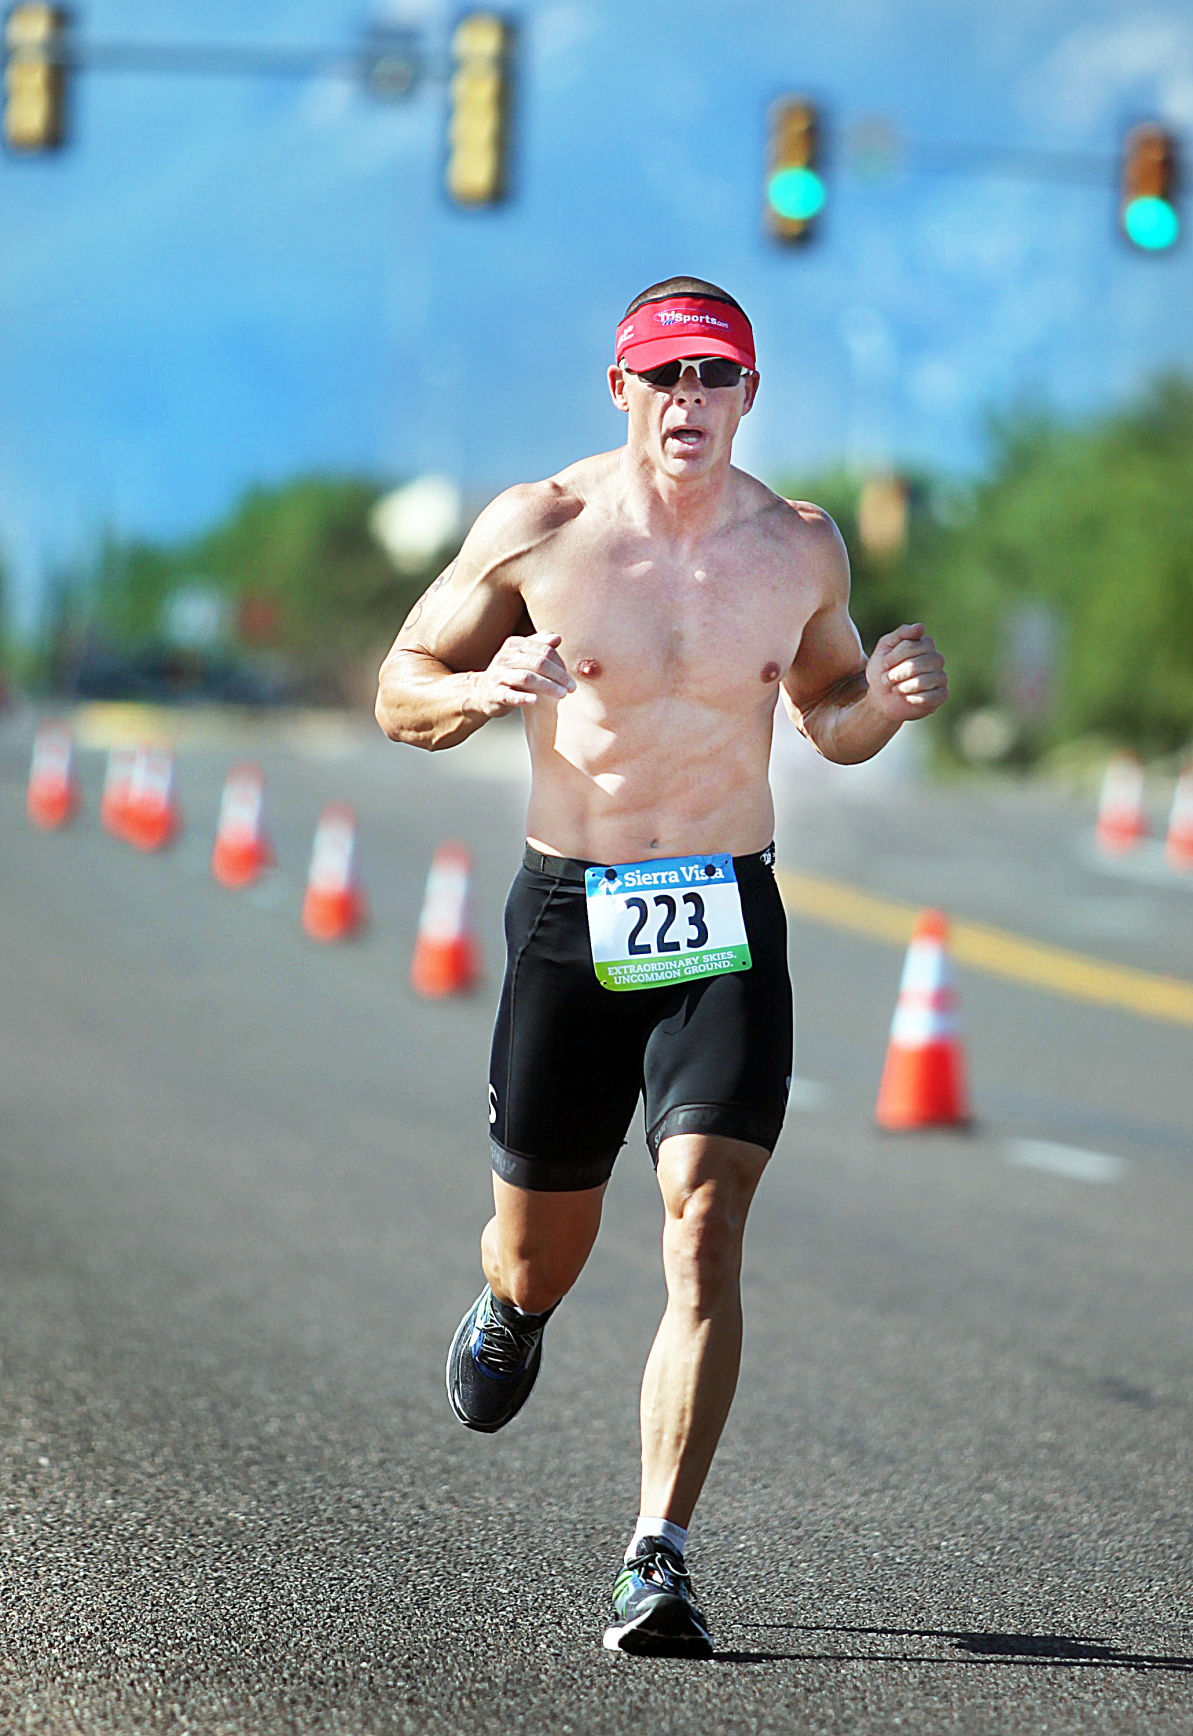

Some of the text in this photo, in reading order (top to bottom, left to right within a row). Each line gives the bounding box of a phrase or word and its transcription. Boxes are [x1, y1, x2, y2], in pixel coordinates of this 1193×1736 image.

[624, 864, 725, 888] Sierra Visa
[624, 891, 709, 956] 223
[607, 951, 737, 976] EXTRAORDINARY SKIES.
[613, 960, 734, 985] UNCOMMON GROUND.
